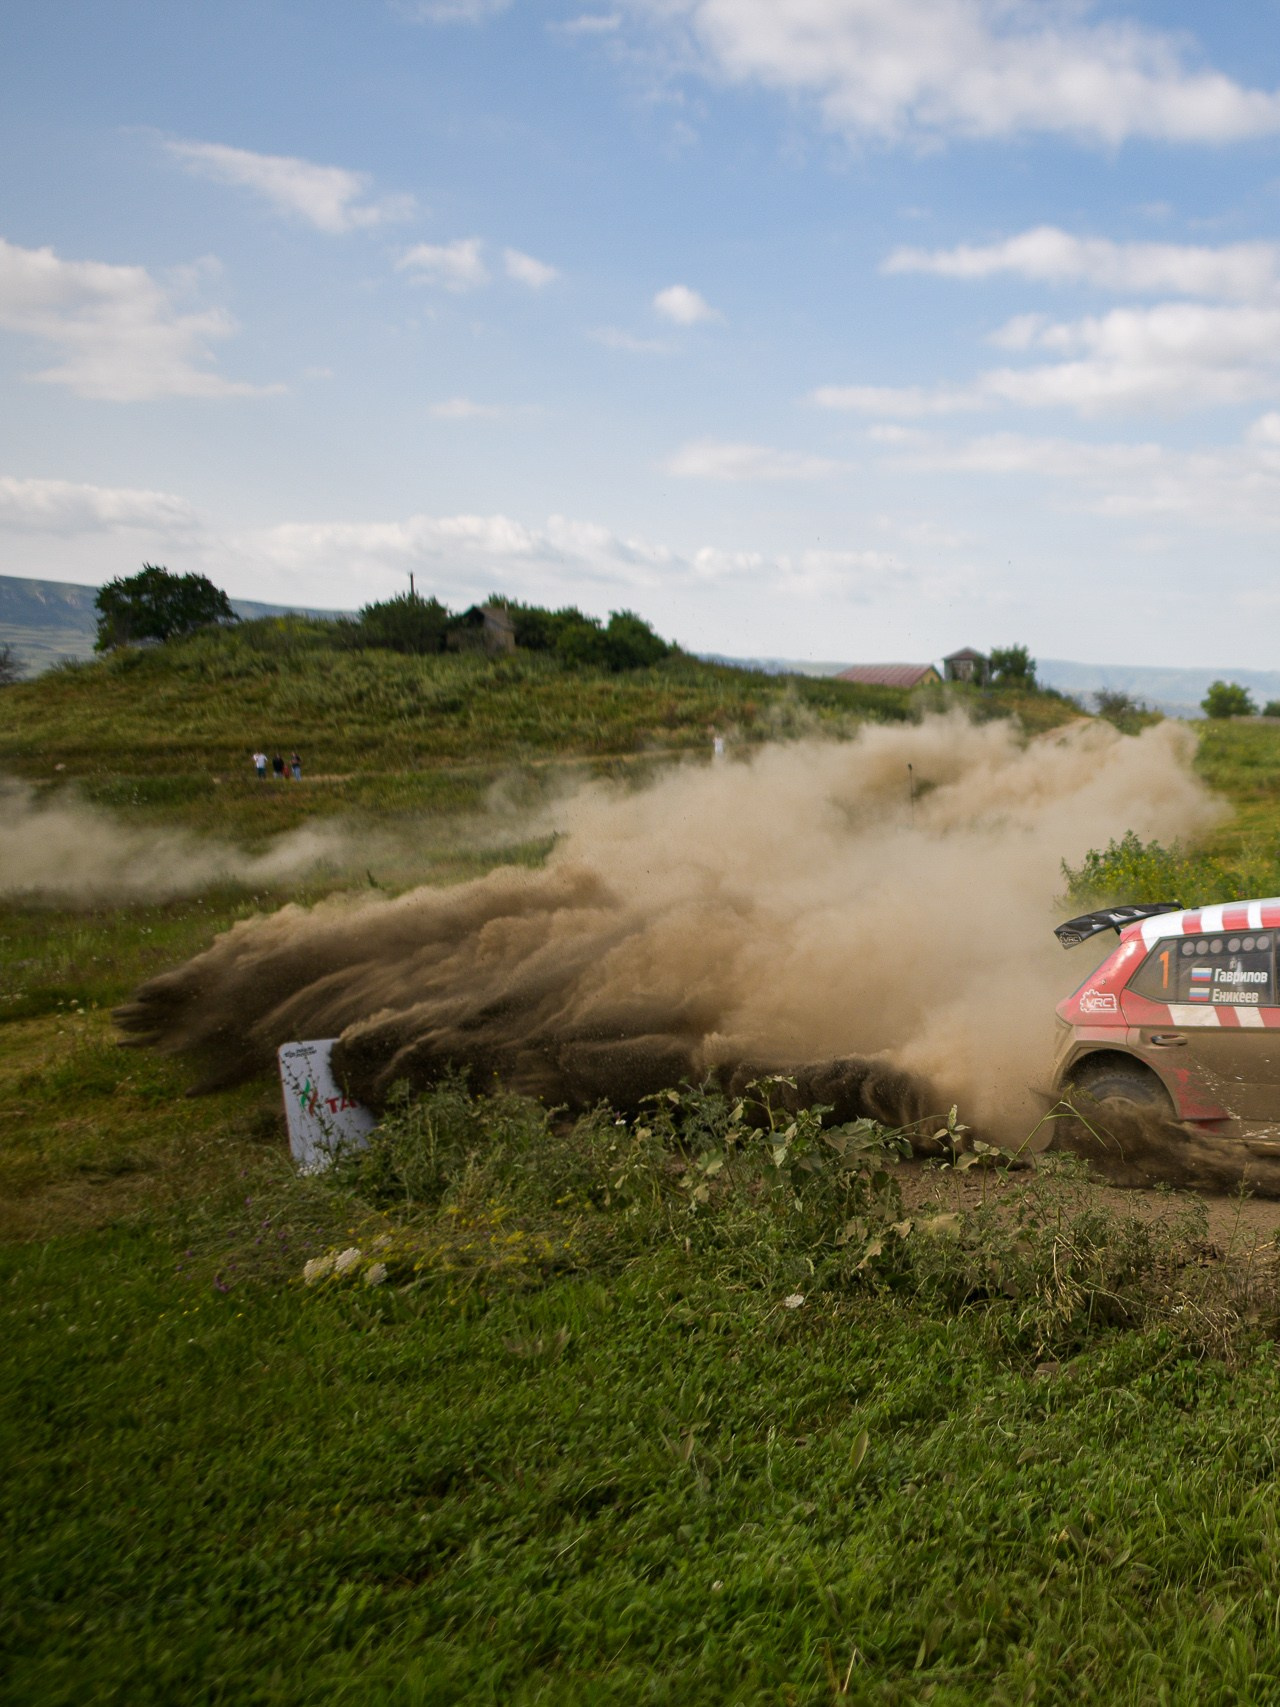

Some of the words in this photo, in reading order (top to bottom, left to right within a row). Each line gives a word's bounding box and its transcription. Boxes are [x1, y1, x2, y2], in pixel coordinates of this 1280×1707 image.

[1159, 950, 1169, 989] 1
[1214, 968, 1268, 984] Гаврилов
[1212, 988, 1259, 1003] Еникеев
[1086, 998, 1112, 1009] VRC
